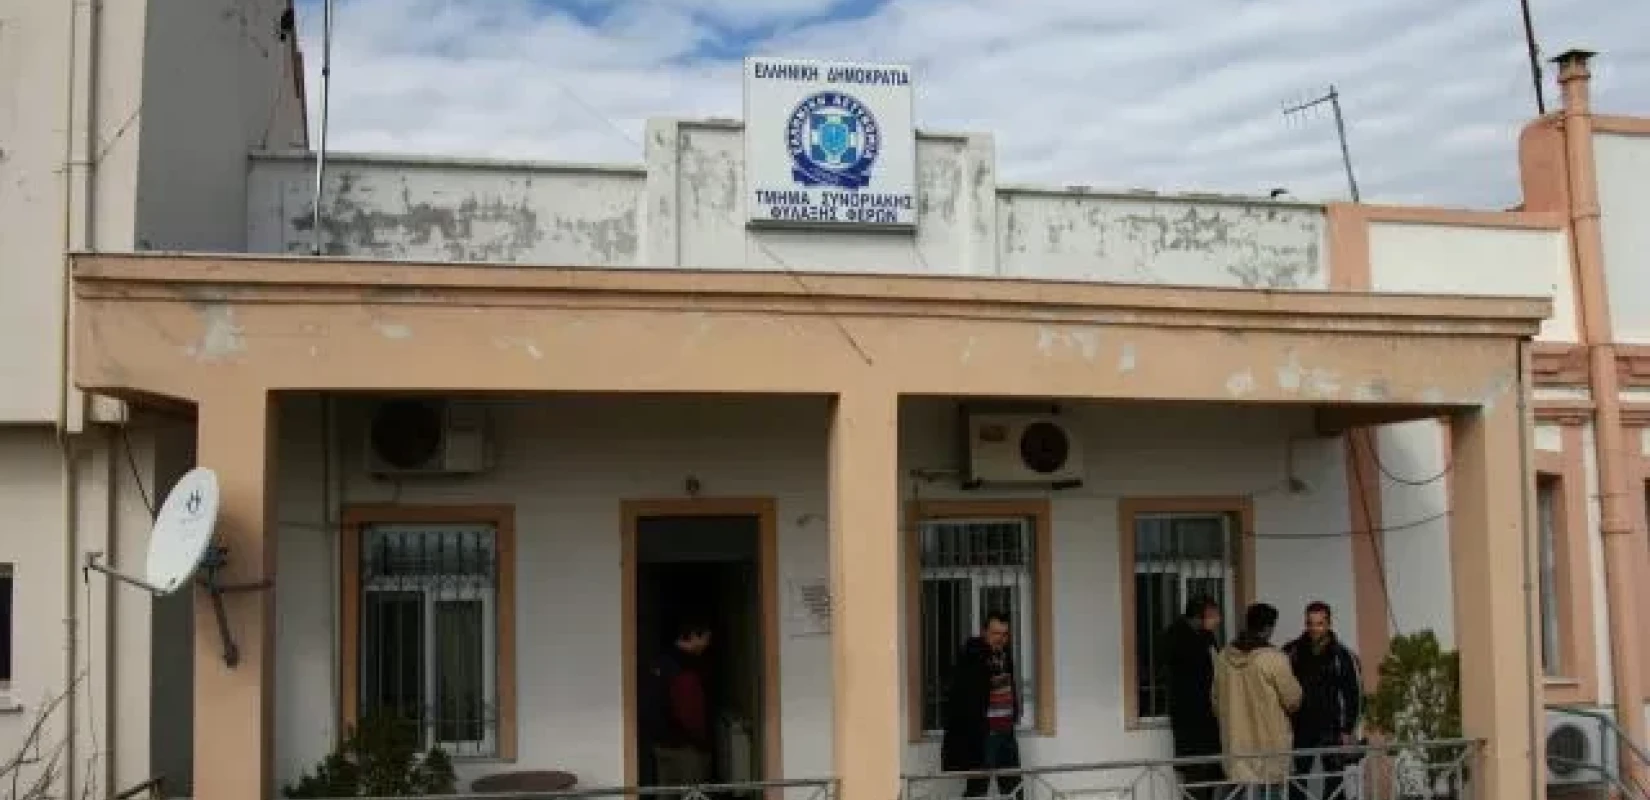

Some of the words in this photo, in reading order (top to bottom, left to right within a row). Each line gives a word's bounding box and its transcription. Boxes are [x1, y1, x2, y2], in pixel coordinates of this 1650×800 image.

[754, 61, 818, 80] ΕΛΛΗΝΙΚΗ
[827, 66, 909, 86] ΔΗΜΟΚΡΑΤΙΑ
[755, 190, 811, 205] ΤΜΗΜΑ
[822, 191, 912, 210] ΣΥΝΟΡΙΑΚΗΣ
[770, 206, 837, 221] ΦΥΛΑΞΗΣ
[846, 208, 898, 222] ΦΕΡΩΝ
